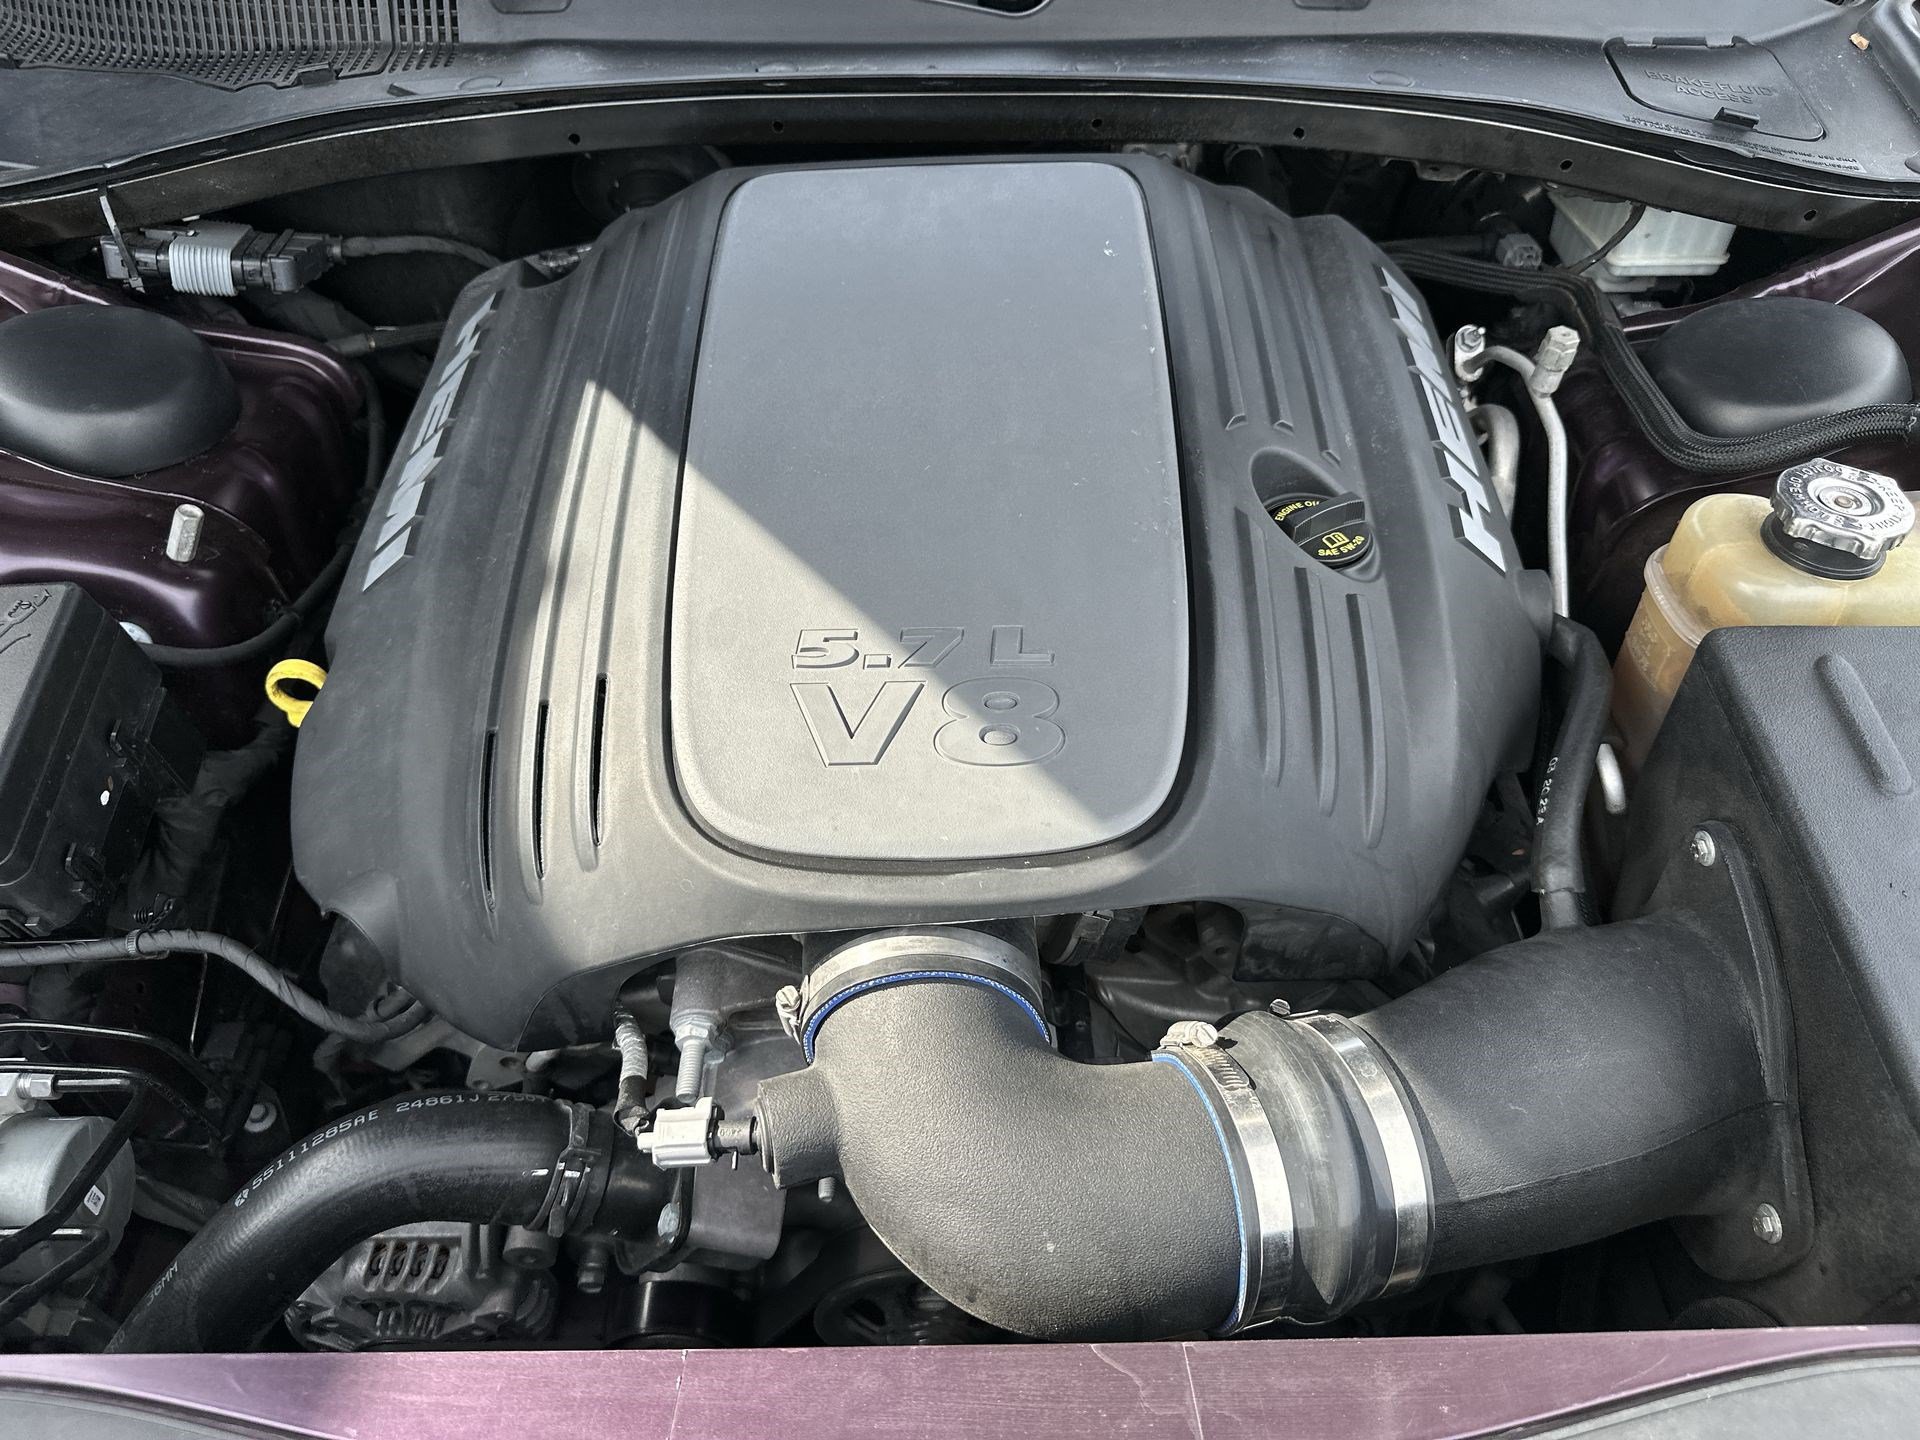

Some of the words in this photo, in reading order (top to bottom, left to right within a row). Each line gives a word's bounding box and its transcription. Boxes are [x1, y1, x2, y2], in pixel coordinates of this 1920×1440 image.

[1643, 69, 1713, 89] BRAKE
[1715, 81, 1775, 97] FLUID
[1676, 84, 1754, 105] ACCESS
[1798, 465, 1823, 479] NOT
[1274, 502, 1304, 522] ENGINE
[1317, 547, 1340, 557] SAE
[1341, 535, 1366, 554] 5W-20
[789, 675, 1067, 768] V8
[252, 1108, 379, 1190] 55111285AE
